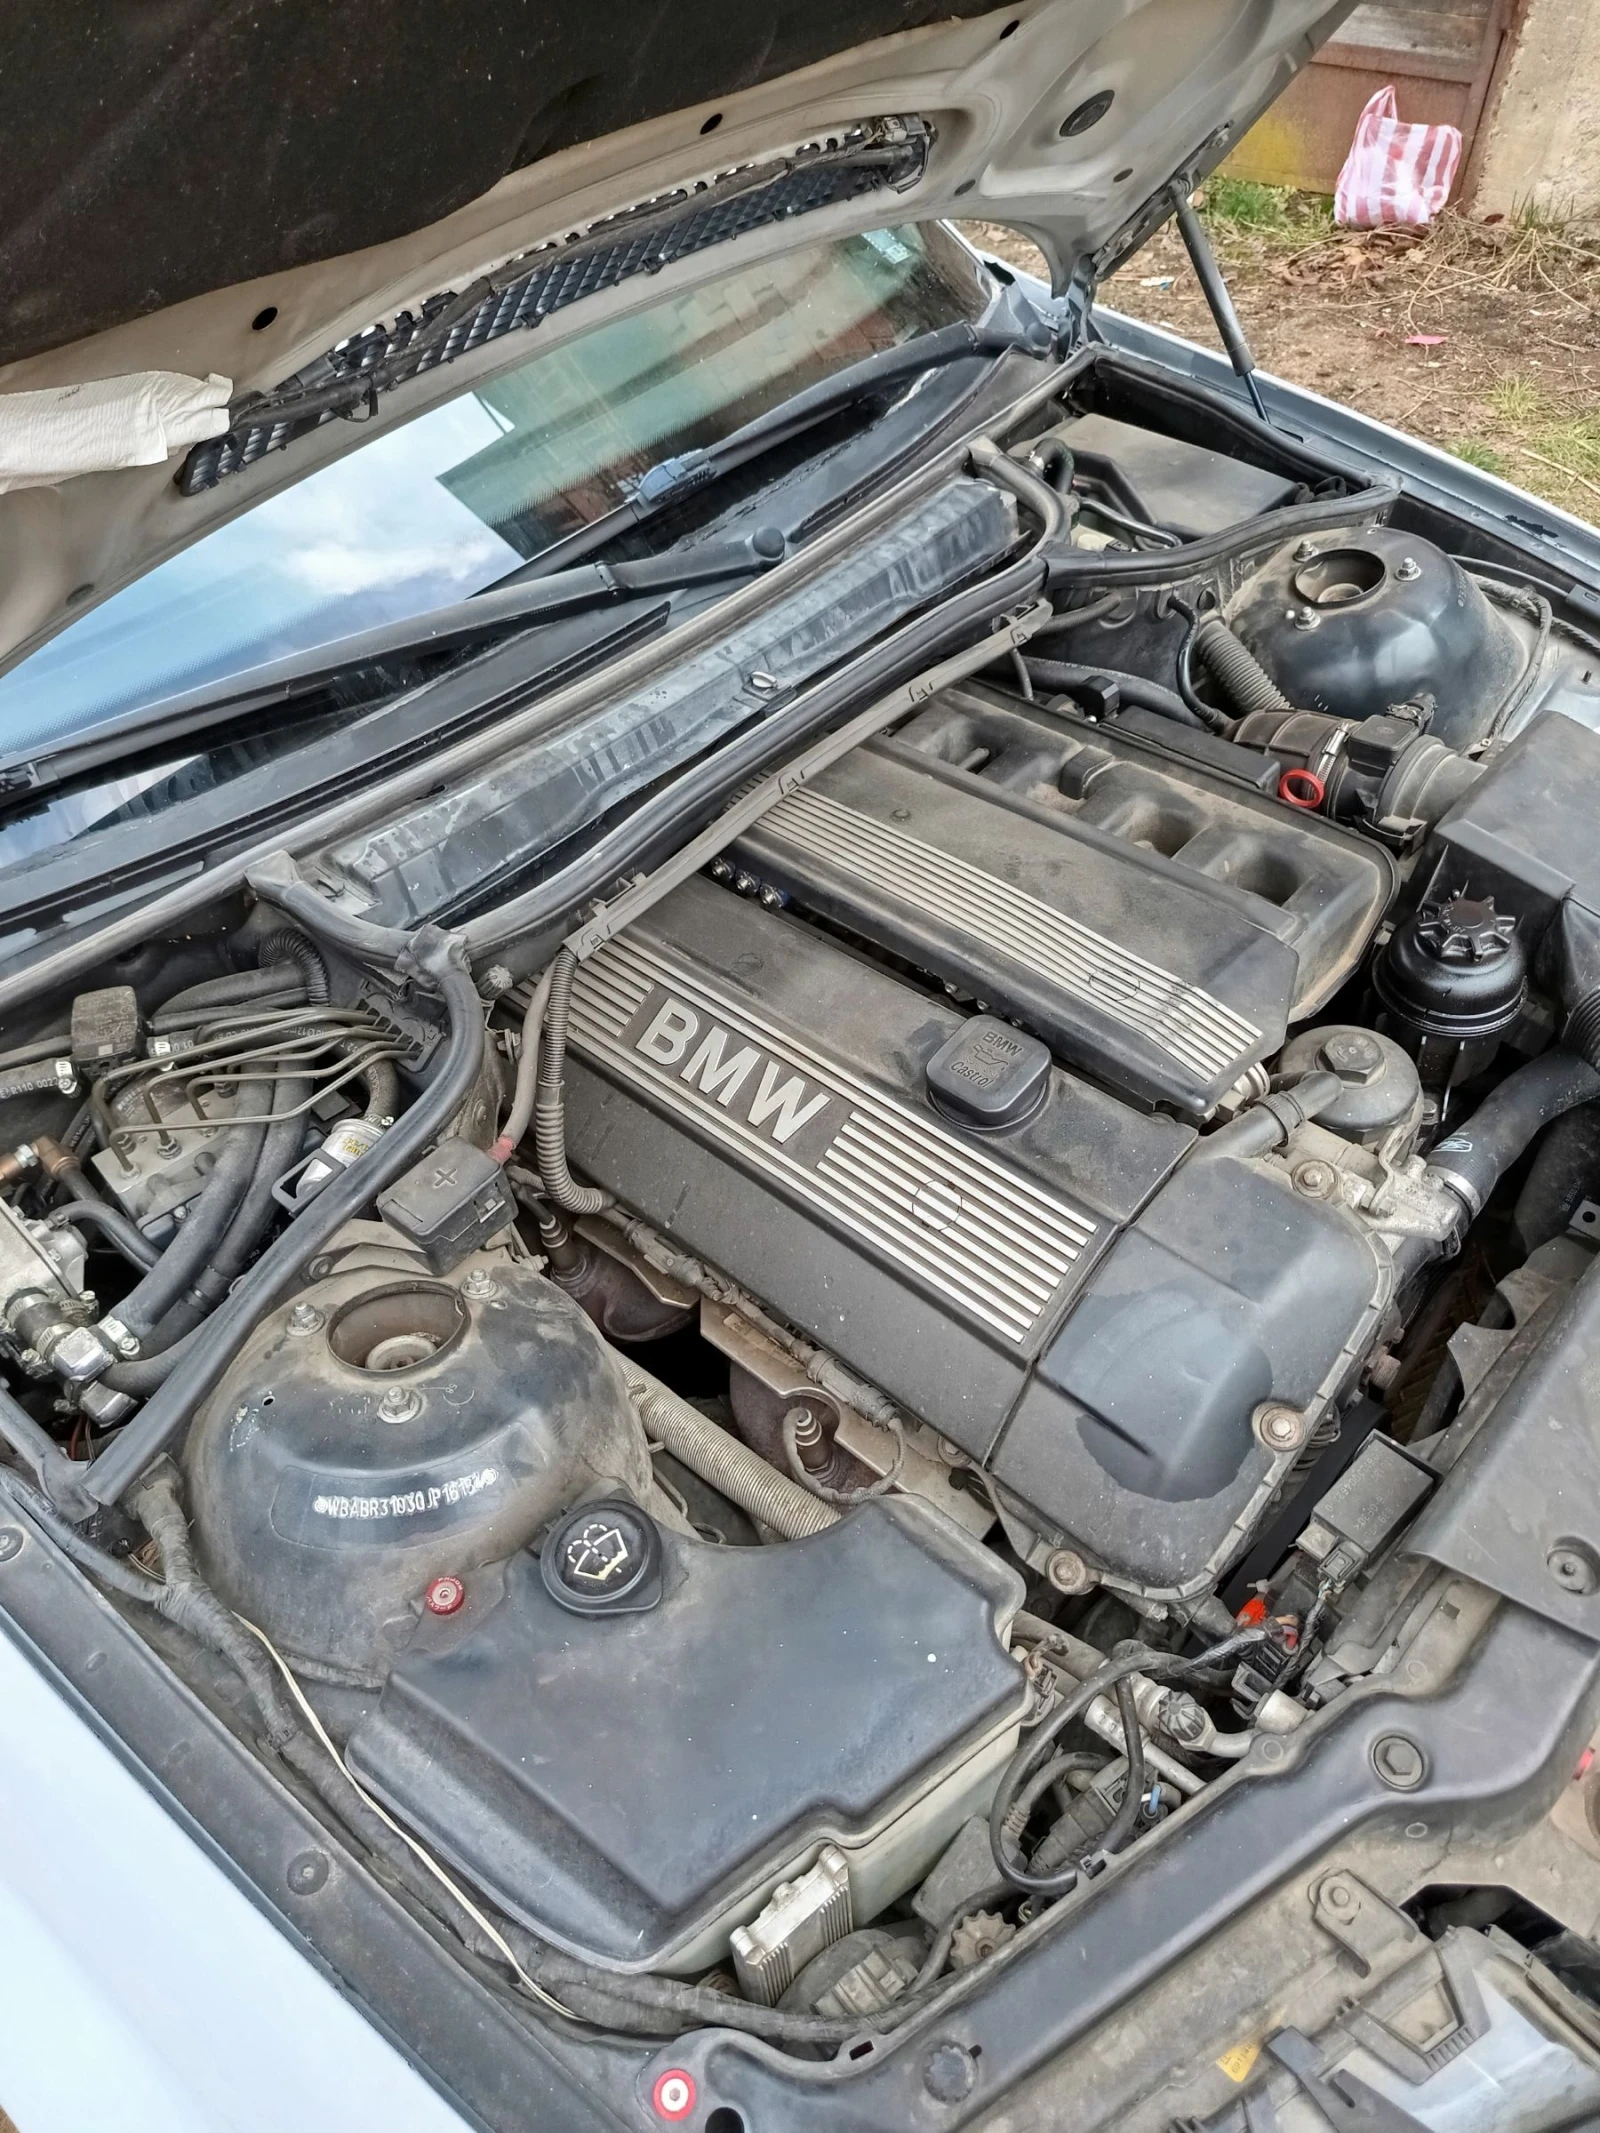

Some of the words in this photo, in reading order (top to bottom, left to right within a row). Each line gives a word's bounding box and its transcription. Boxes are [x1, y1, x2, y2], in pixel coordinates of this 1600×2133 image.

[982, 1031, 1023, 1057] BMW
[635, 998, 831, 1144] BMW
[950, 1061, 995, 1088] Castrol
